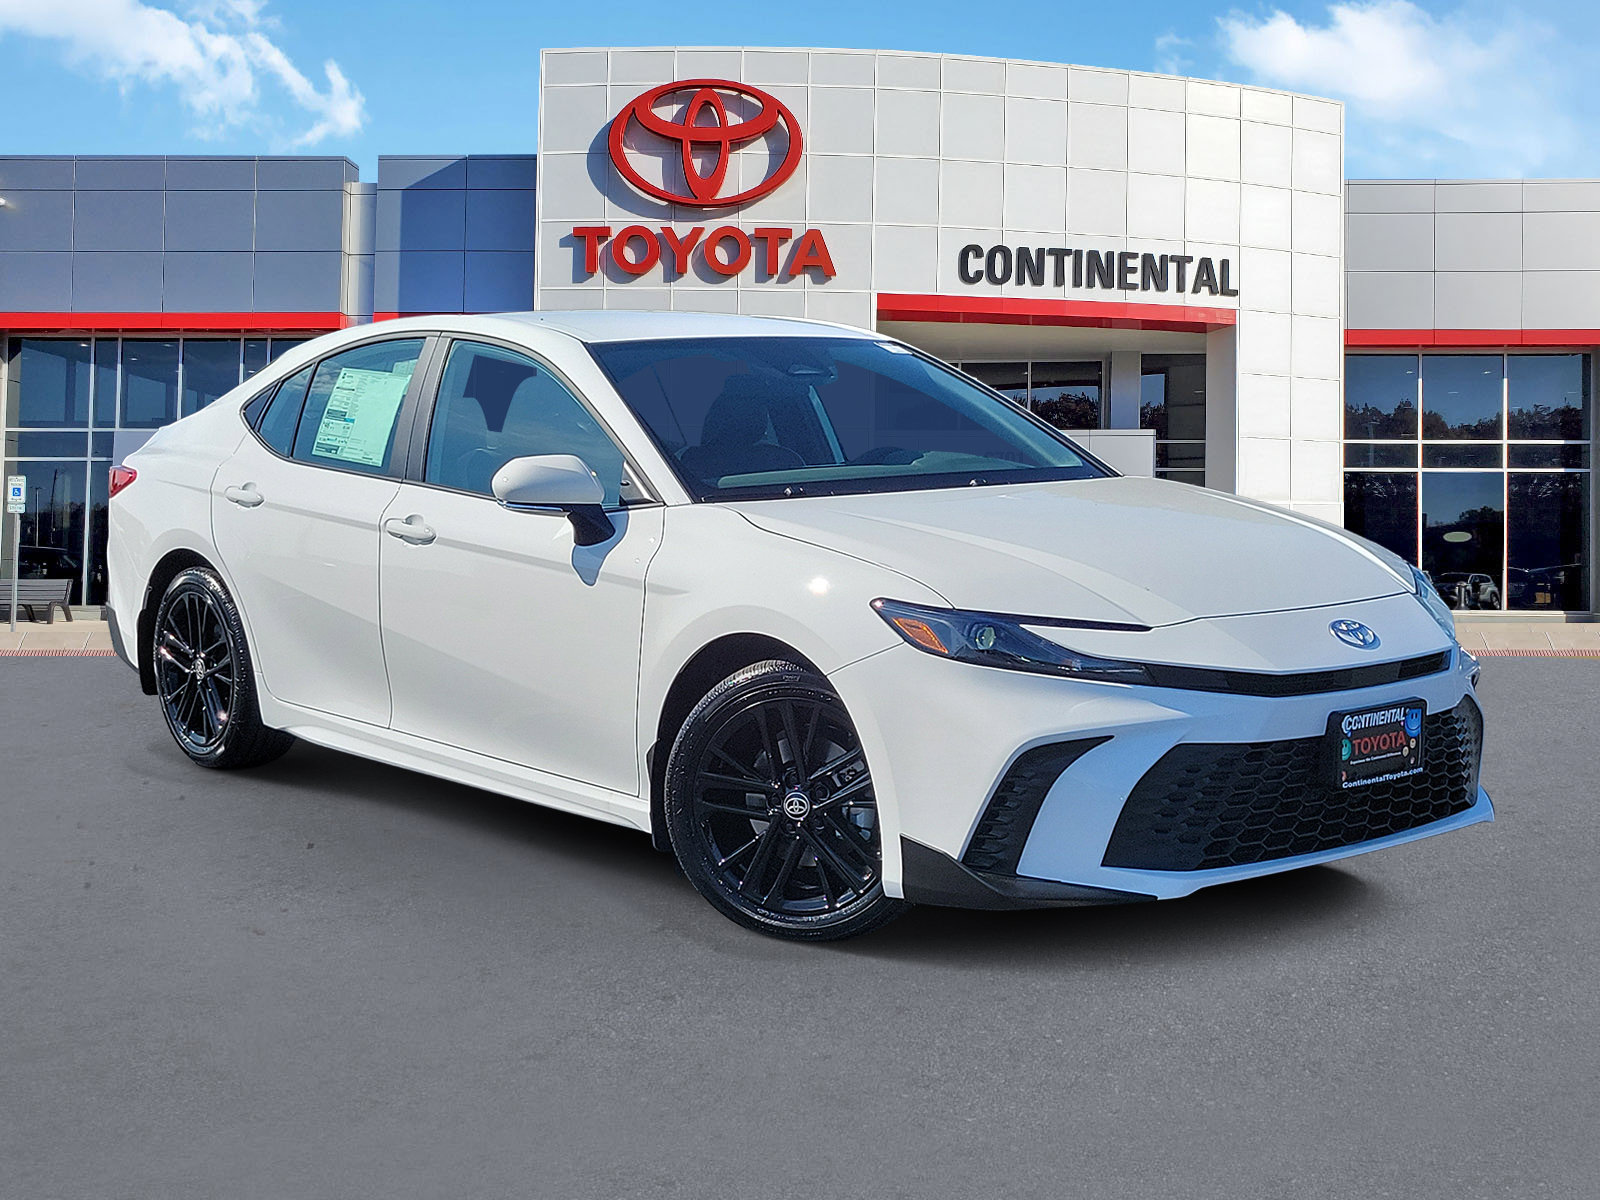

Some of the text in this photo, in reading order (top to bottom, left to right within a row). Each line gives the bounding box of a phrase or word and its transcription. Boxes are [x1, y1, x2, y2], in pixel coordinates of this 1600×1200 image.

[572, 225, 836, 277] TOYOTA
[958, 244, 1238, 297] CONTINENTAL
[1342, 707, 1405, 733] CONTINENTAL
[1353, 731, 1406, 755] TOYOTA
[1342, 767, 1423, 788] ContinentalToyota.com
